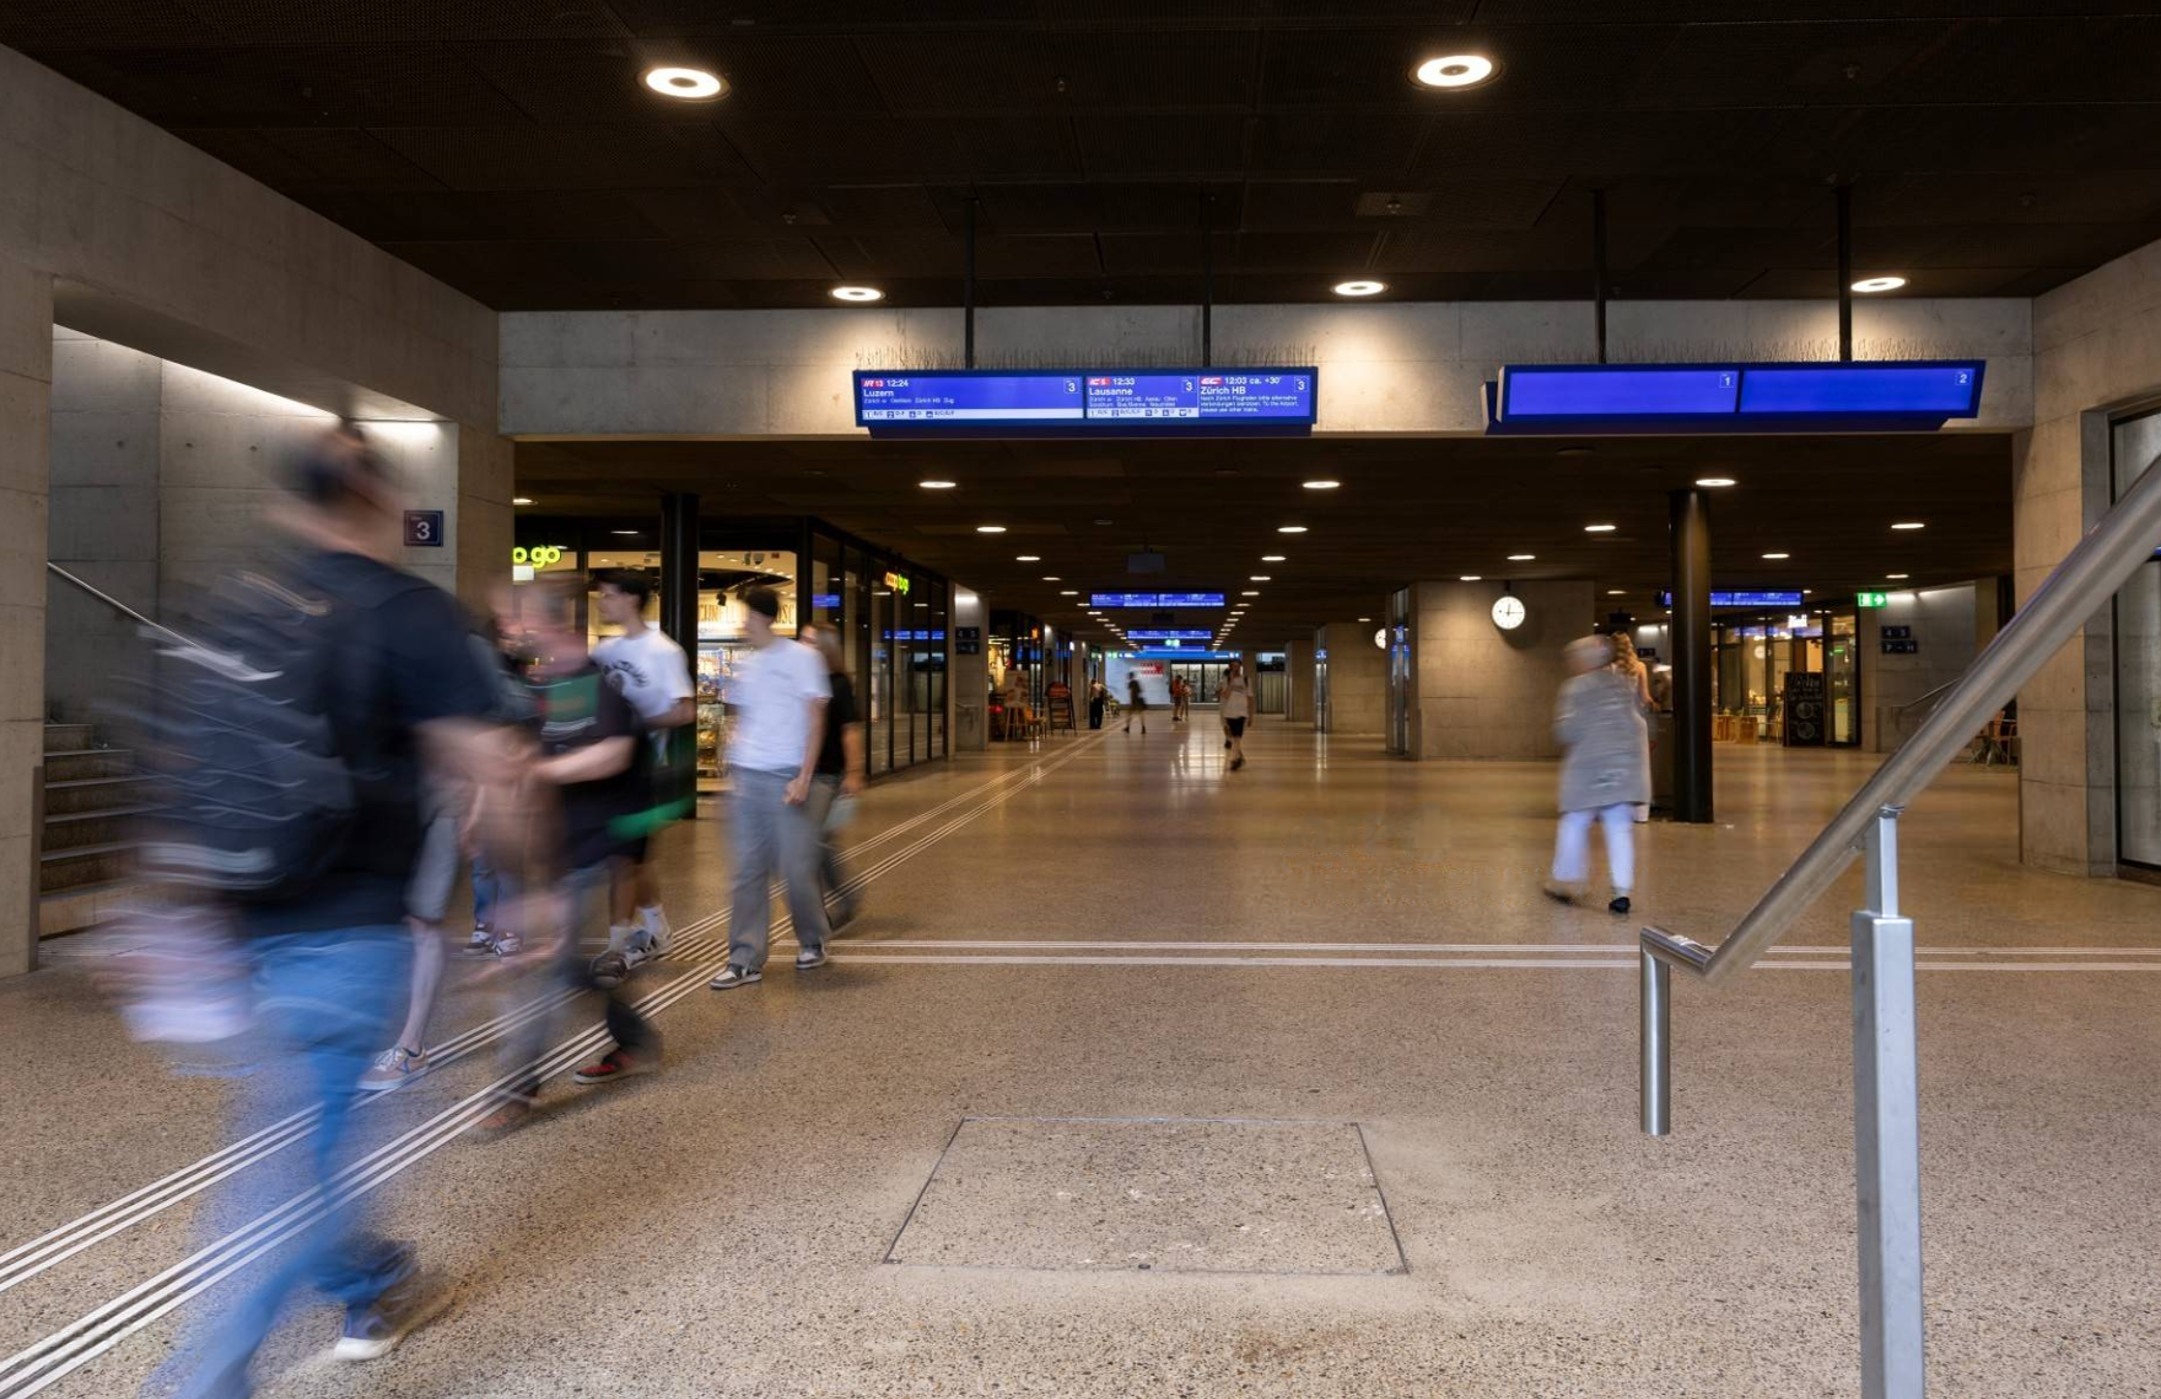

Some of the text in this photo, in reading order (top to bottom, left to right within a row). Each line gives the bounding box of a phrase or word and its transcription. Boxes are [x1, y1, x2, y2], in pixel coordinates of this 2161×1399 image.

[1112, 377, 1135, 385] 12:33
[1224, 376, 1247, 384] 12:03
[1725, 377, 1730, 386] 1
[1959, 373, 1968, 384] 2
[886, 379, 909, 388] 12:24
[1068, 382, 1076, 391] 3
[1185, 382, 1193, 391] 3
[1298, 381, 1305, 390] 3
[863, 389, 894, 397] Luzern
[1089, 388, 1133, 396] Lausanne
[1200, 386, 1246, 394] Zürich HB
[416, 521, 431, 540] 3
[531, 546, 561, 568] go
